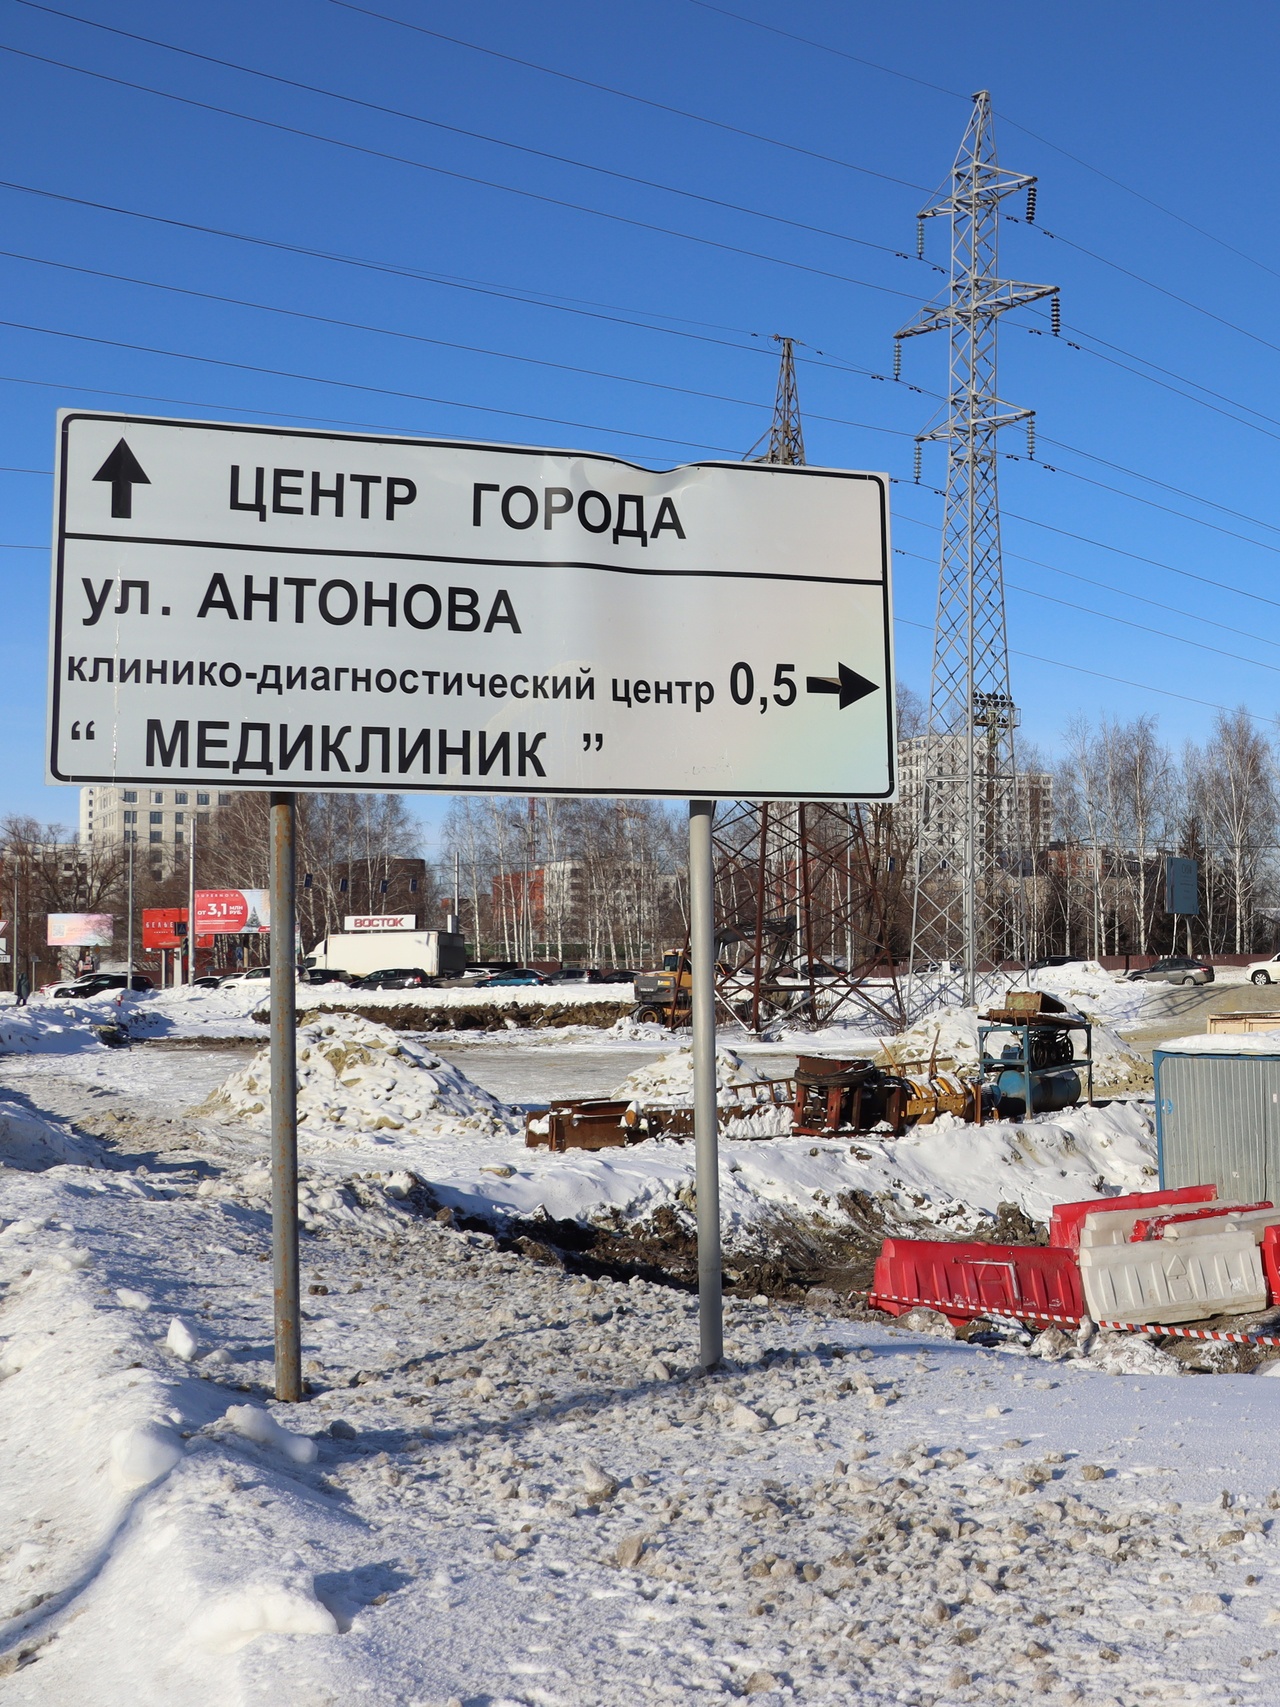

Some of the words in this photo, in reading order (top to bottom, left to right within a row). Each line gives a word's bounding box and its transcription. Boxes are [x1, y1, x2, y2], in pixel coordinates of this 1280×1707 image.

[229, 464, 418, 523] ЦЕНТР
[472, 482, 687, 548] ГОРОДА
[81, 577, 171, 626] ул.
[196, 572, 522, 634] АНТОНОВА
[66, 655, 595, 700] клинико-диагностический
[611, 678, 715, 713] центр
[729, 661, 798, 715] 0,5
[145, 718, 547, 777] МЕДИКЛИНИК
[207, 903, 227, 917] 3,1
[354, 918, 404, 927] ВОСТОК
